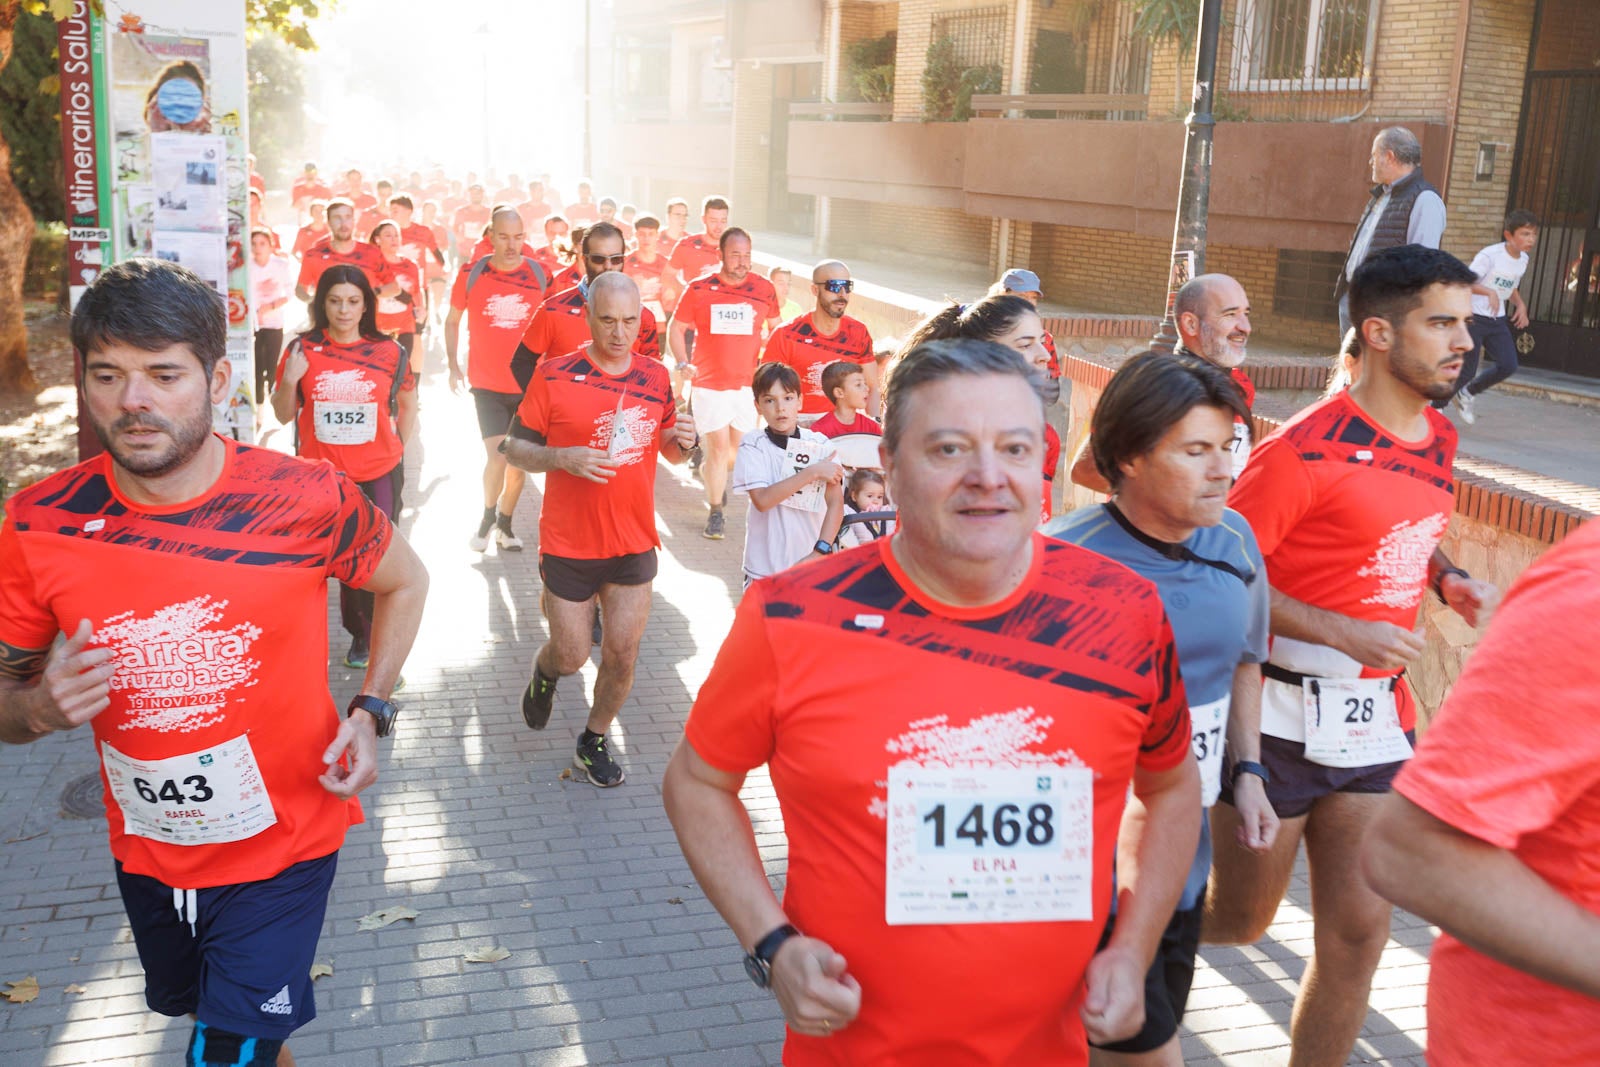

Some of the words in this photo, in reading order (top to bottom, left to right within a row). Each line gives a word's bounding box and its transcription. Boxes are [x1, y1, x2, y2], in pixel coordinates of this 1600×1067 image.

[718, 311, 744, 320] 1401
[323, 411, 365, 425] 1352
[109, 662, 249, 692] cruzroja.es
[150, 695, 182, 709] NOV
[189, 692, 226, 707] 2023
[1344, 698, 1374, 723] 28
[133, 774, 214, 805] 643
[165, 808, 206, 819] RAFAEL
[923, 803, 1055, 847] 1468
[973, 858, 989, 872] EL
[993, 858, 1017, 872] PLA
[260, 1002, 293, 1015] adidas
